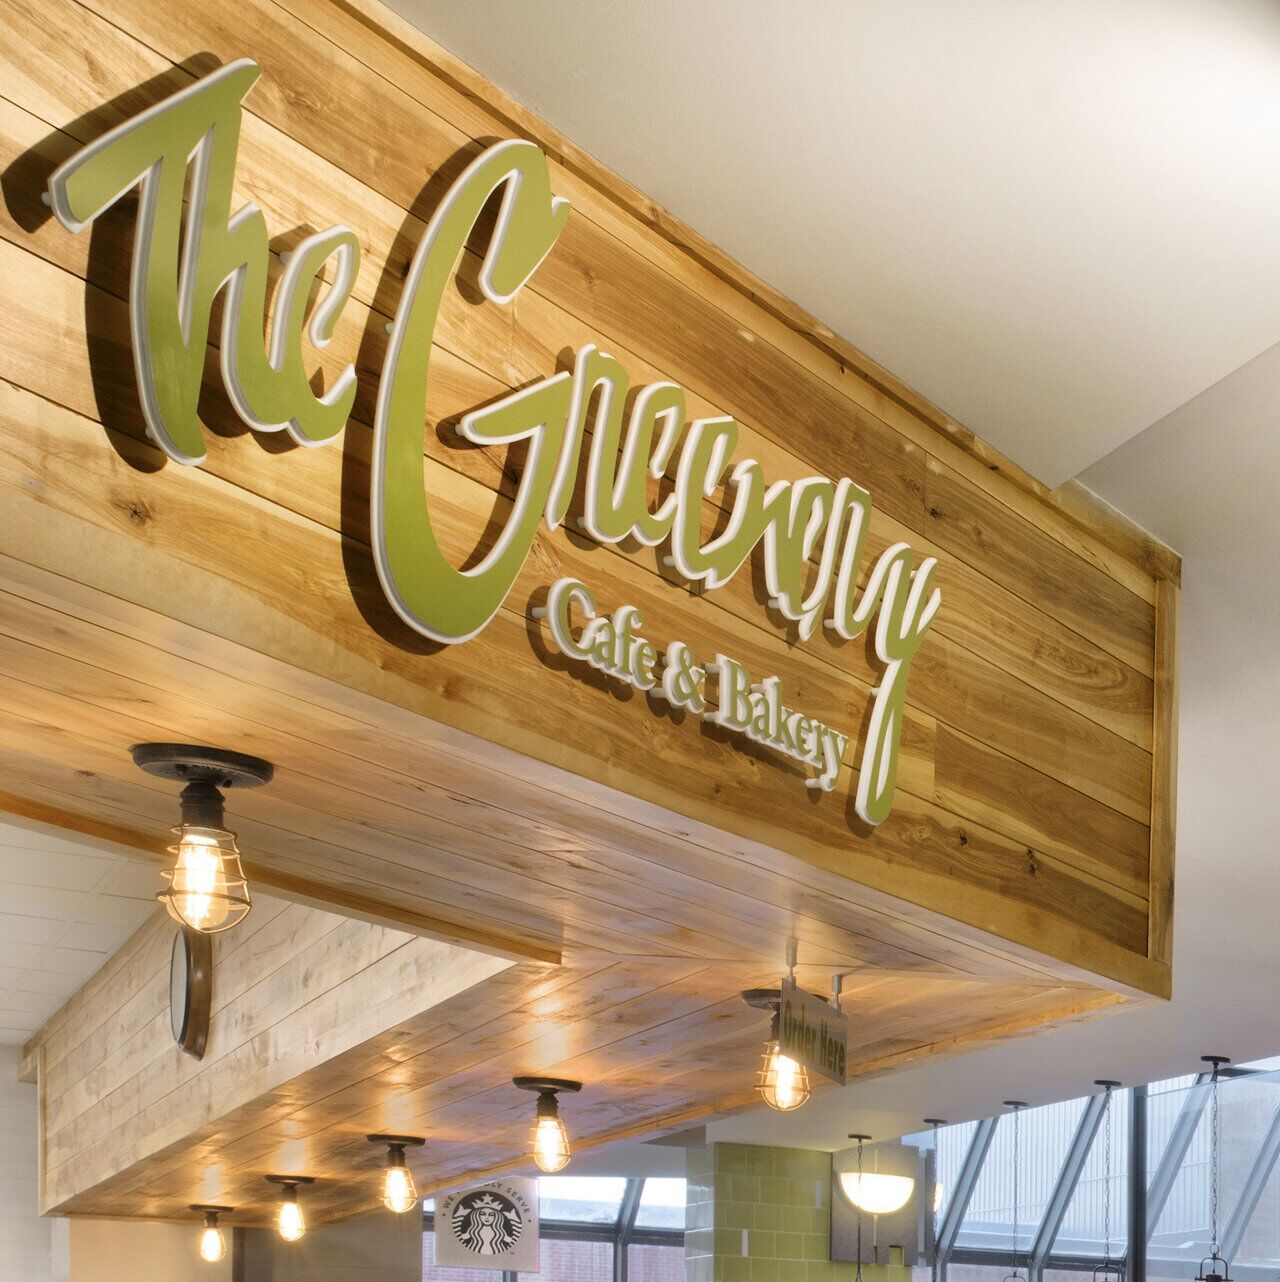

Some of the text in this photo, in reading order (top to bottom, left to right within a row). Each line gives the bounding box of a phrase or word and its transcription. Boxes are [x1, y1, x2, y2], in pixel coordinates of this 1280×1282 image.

[47, 56, 942, 826] The Greenery
[547, 576, 850, 793] Cafe & Bakery
[783, 999, 845, 1077] Order Here
[506, 1186, 531, 1214] SERVE
